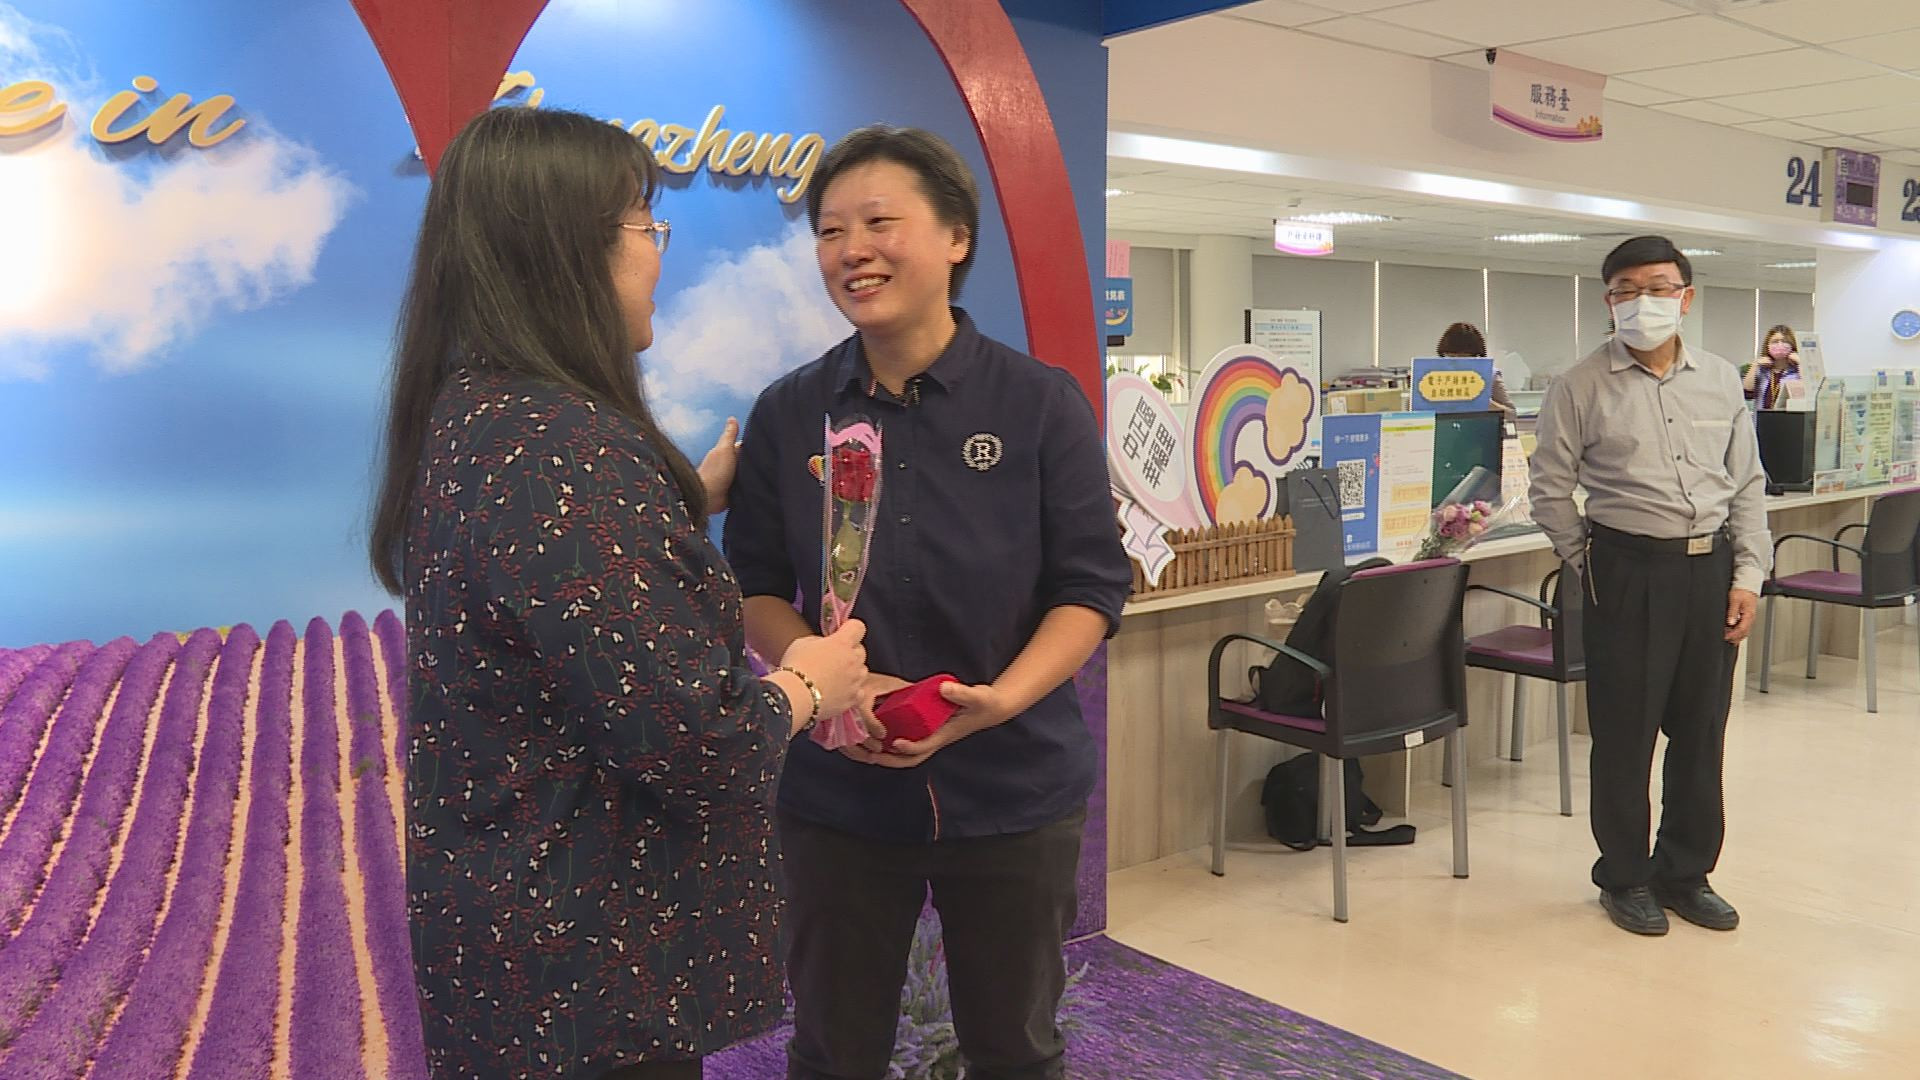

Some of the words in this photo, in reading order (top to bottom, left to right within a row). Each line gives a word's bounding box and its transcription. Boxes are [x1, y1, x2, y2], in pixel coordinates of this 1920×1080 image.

[91, 75, 246, 147] in
[1531, 84, 1571, 111] 服務臺
[1786, 157, 1822, 207] 24
[1902, 178, 1920, 221] 2
[974, 442, 993, 461] R
[1122, 395, 1157, 460] 中正區
[1142, 422, 1177, 489] 幸福里
